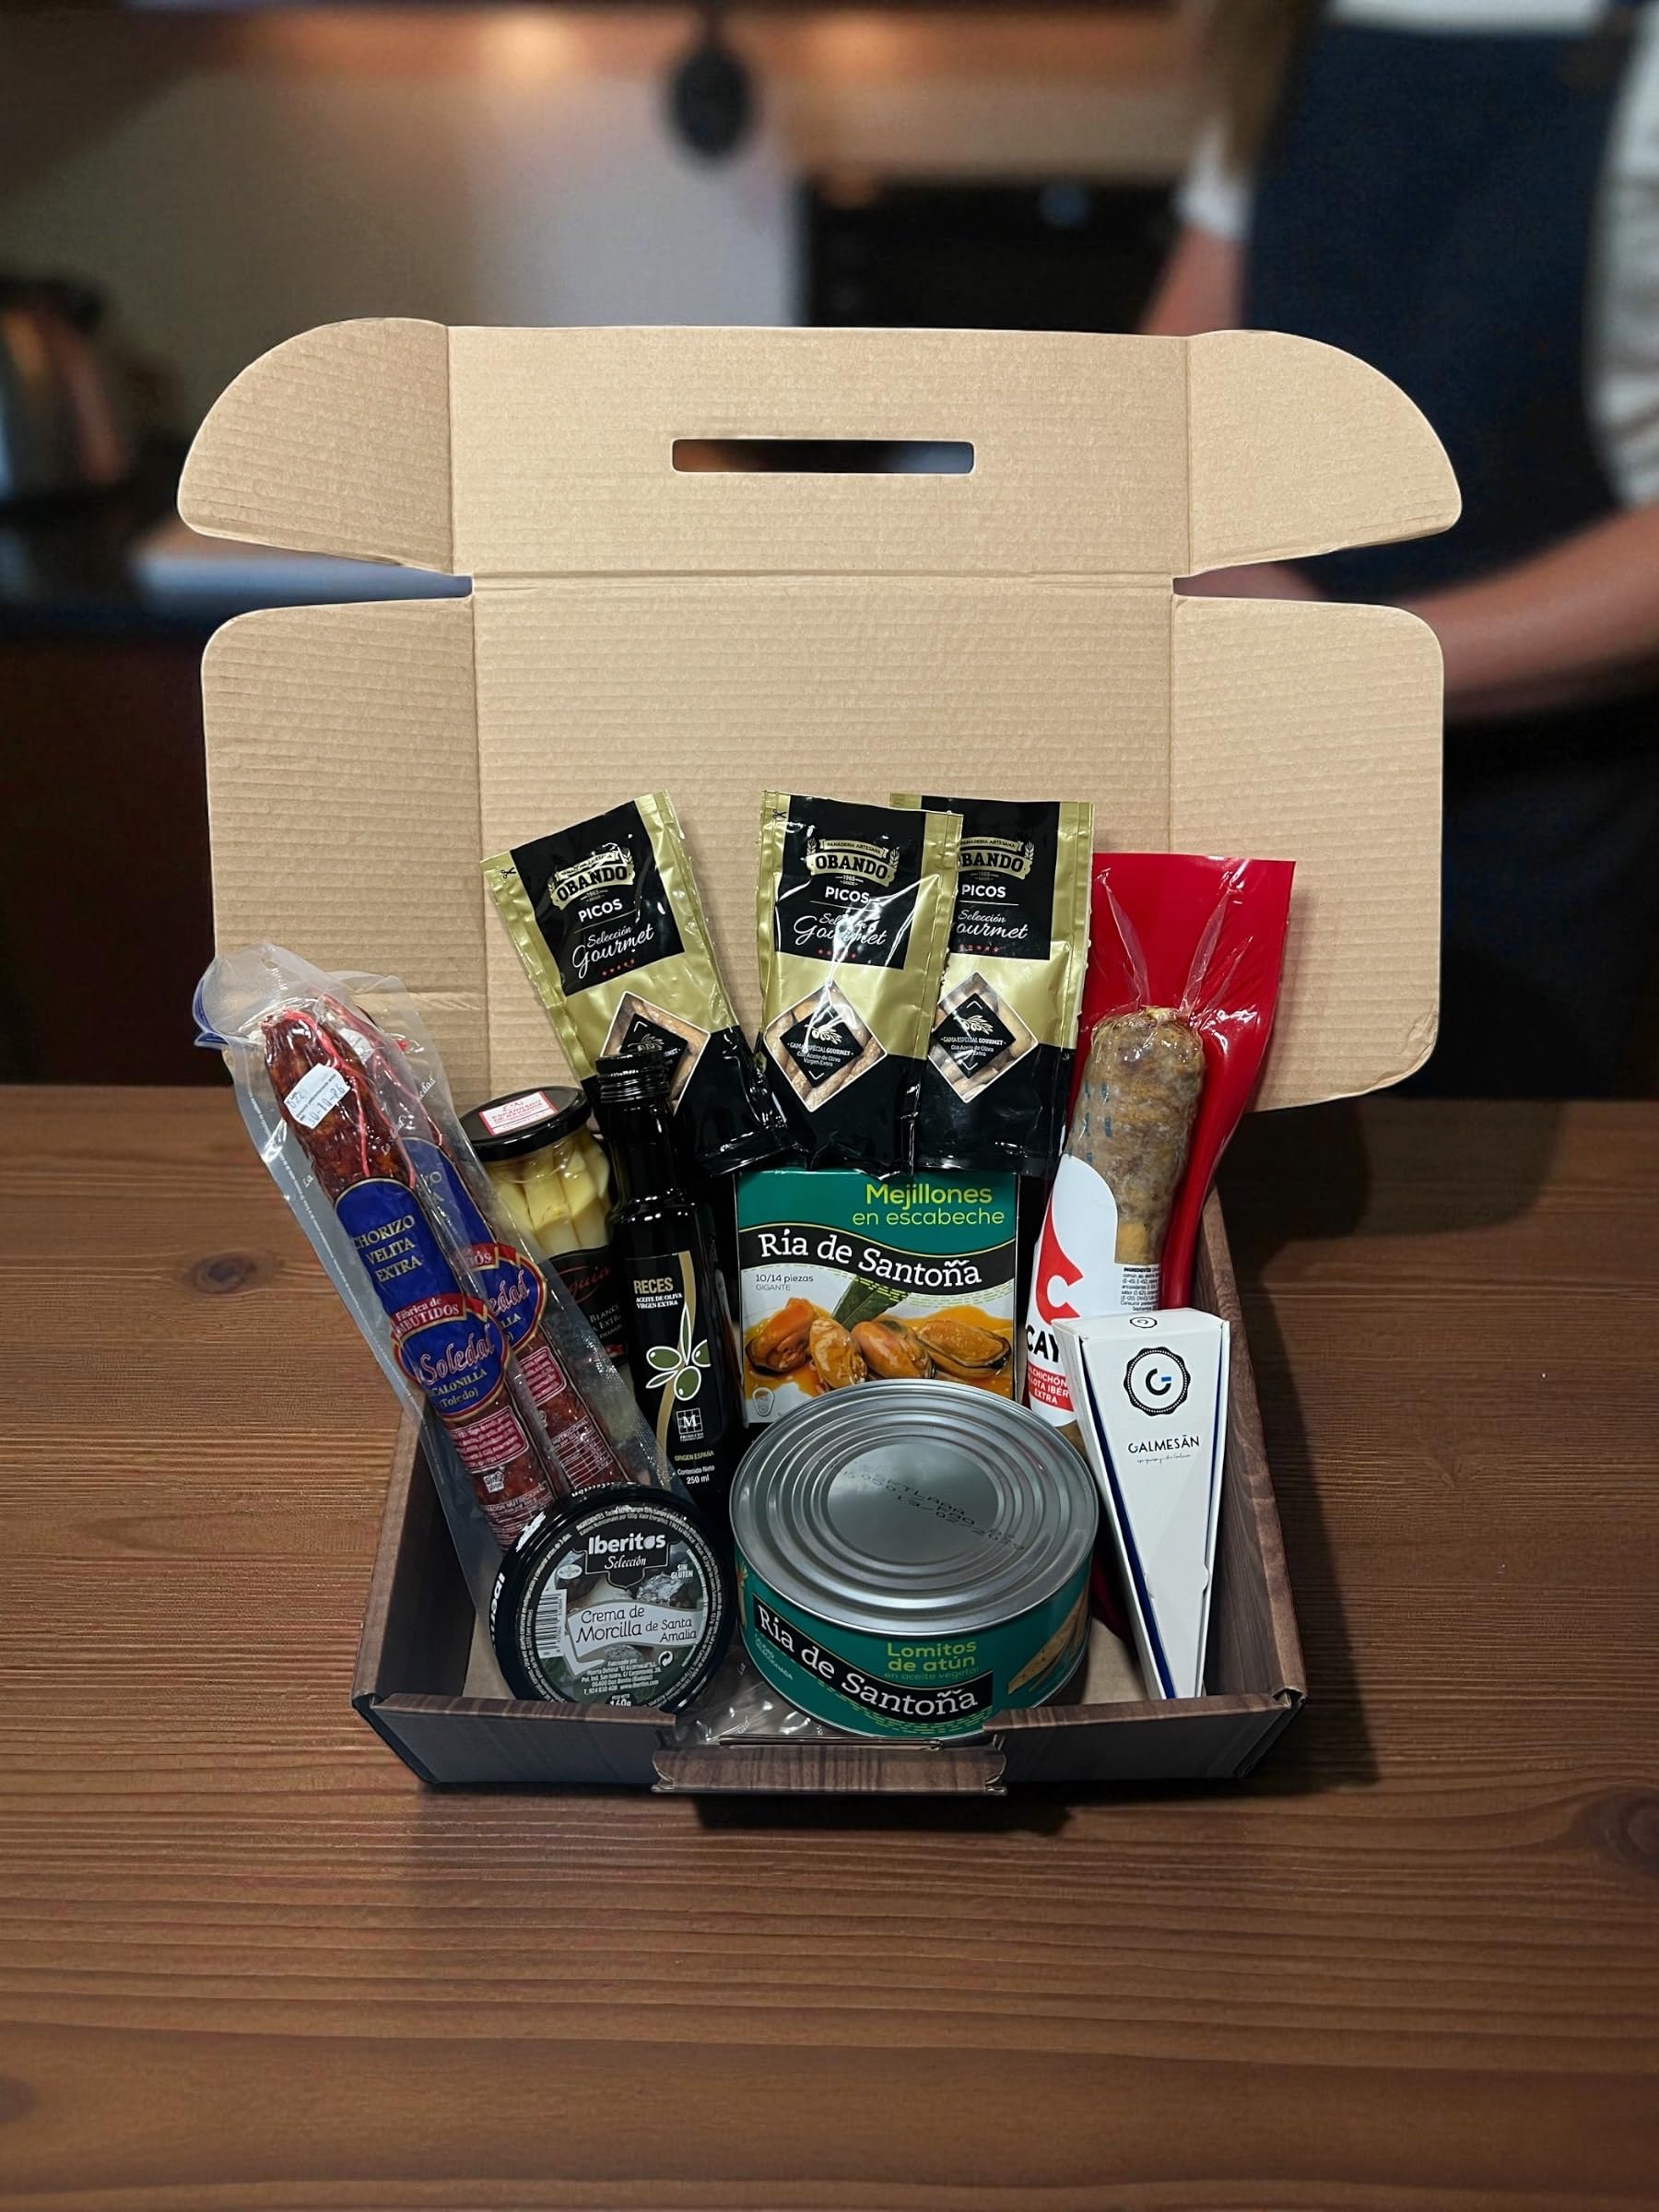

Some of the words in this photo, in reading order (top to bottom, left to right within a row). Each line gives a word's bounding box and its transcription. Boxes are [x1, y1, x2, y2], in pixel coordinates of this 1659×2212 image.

[815, 855, 888, 878] OBANDO
[557, 865, 628, 902] OBANDO
[961, 885, 1006, 899] PICOS
[825, 886, 870, 904] PICOS
[578, 898, 623, 923] PICOS
[957, 909, 1007, 924] Selección
[587, 924, 632, 947] Selección
[955, 924, 1029, 939] ourmet
[571, 923, 654, 980] Gourmet
[866, 1183, 993, 1210] Mejillones
[853, 1212, 879, 1225] en
[886, 1207, 1005, 1225] escabeche
[354, 1215, 415, 1249] CHORIZO
[365, 1237, 416, 1265] VELITA
[758, 1229, 808, 1258] Ría
[817, 1234, 853, 1264] de
[858, 1247, 982, 1288] Santoña
[374, 1255, 422, 1282] EXTRA
[634, 1277, 674, 1294] RECES
[756, 1274, 782, 1282] 10/14
[784, 1275, 814, 1283] piezas
[429, 1297, 441, 1307] de
[657, 1300, 678, 1308] EXTRA
[665, 1292, 683, 1300] OLIVA
[419, 1323, 495, 1386] Soledad
[1035, 1388, 1057, 1406] EXTRA
[683, 1414, 698, 1428] M
[687, 1476, 700, 1485] 250
[701, 1474, 710, 1482] ml
[589, 1533, 666, 1555] Iberitos
[605, 1555, 647, 1570] Selección
[677, 1564, 688, 1572] SIN
[670, 1571, 693, 1580] GLUTEN
[581, 1609, 626, 1625] Crema
[629, 1605, 645, 1618] de
[575, 1620, 642, 1643] Morcilla
[645, 1621, 659, 1632] de
[661, 1618, 693, 1630] Santa
[659, 1629, 698, 1643] Amalia
[888, 1641, 977, 1658] Lomitos
[888, 1658, 916, 1672] de
[923, 1656, 975, 1672] atún
[801, 1645, 835, 1679] de
[841, 1672, 978, 1716] Santoña
[900, 1673, 936, 1681] aceite
[938, 1667, 979, 1680] vegetal
